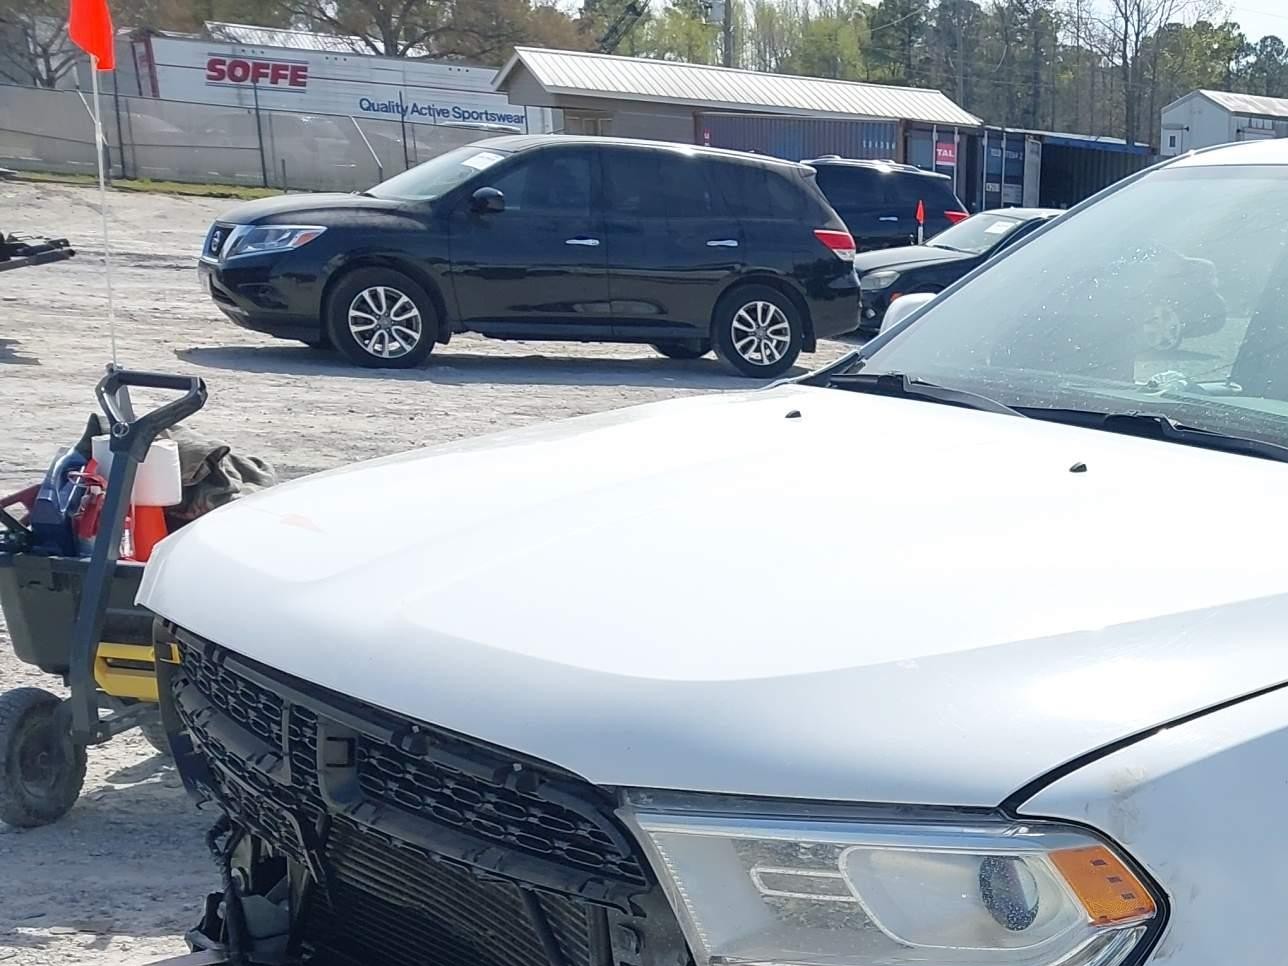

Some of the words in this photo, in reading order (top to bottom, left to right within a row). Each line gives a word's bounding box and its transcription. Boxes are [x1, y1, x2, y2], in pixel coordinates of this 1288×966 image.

[206, 58, 308, 87] SOFFE
[359, 97, 408, 117] Quality
[411, 102, 450, 118] Active
[452, 105, 524, 124] Sportswear
